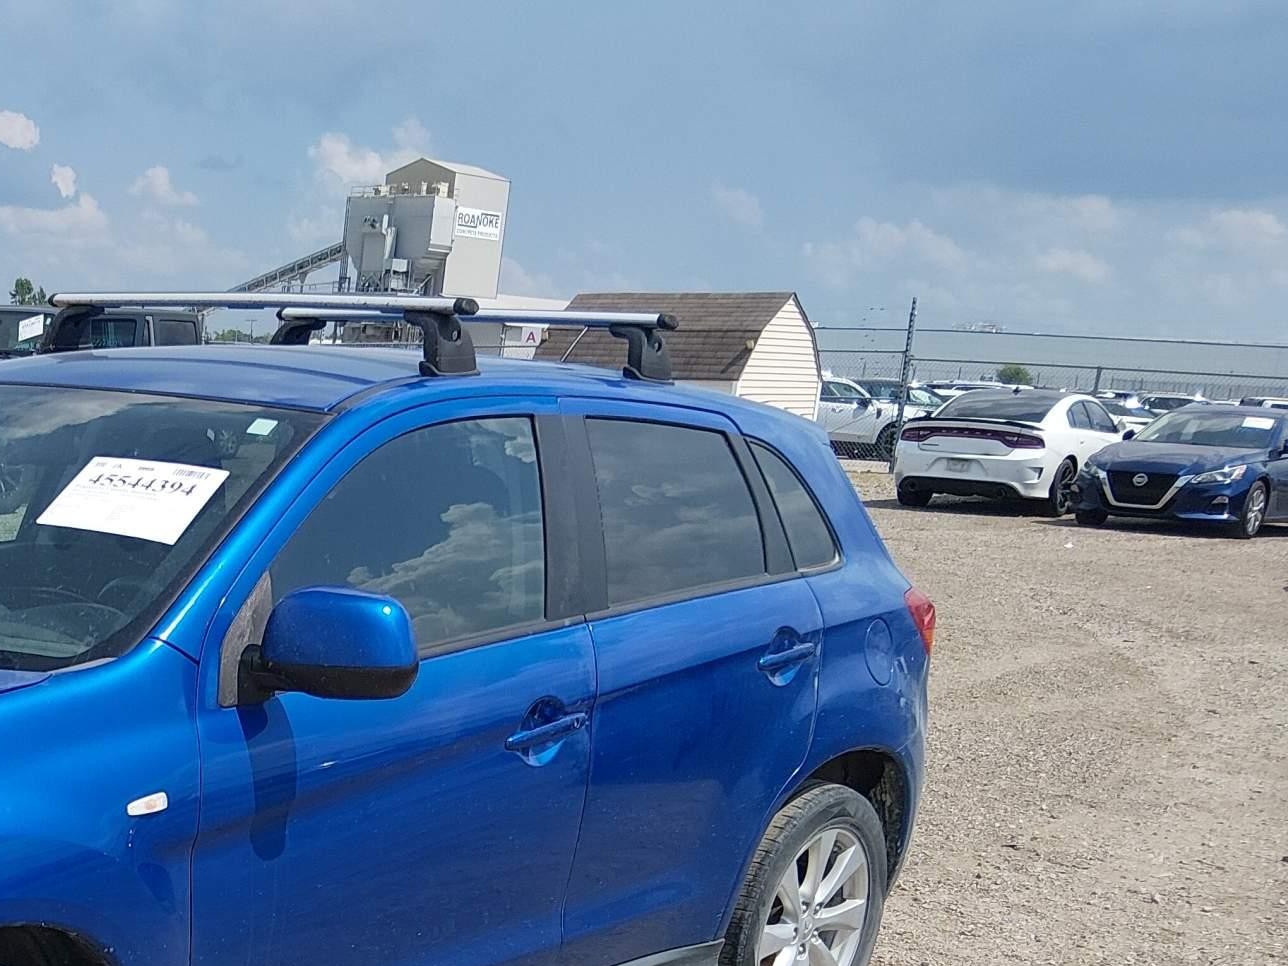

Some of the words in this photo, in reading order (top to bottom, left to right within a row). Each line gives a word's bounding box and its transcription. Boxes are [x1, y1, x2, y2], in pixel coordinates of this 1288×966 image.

[457, 212, 500, 229] ROANOKE
[526, 331, 536, 343] A
[89, 474, 197, 495] 45544394
